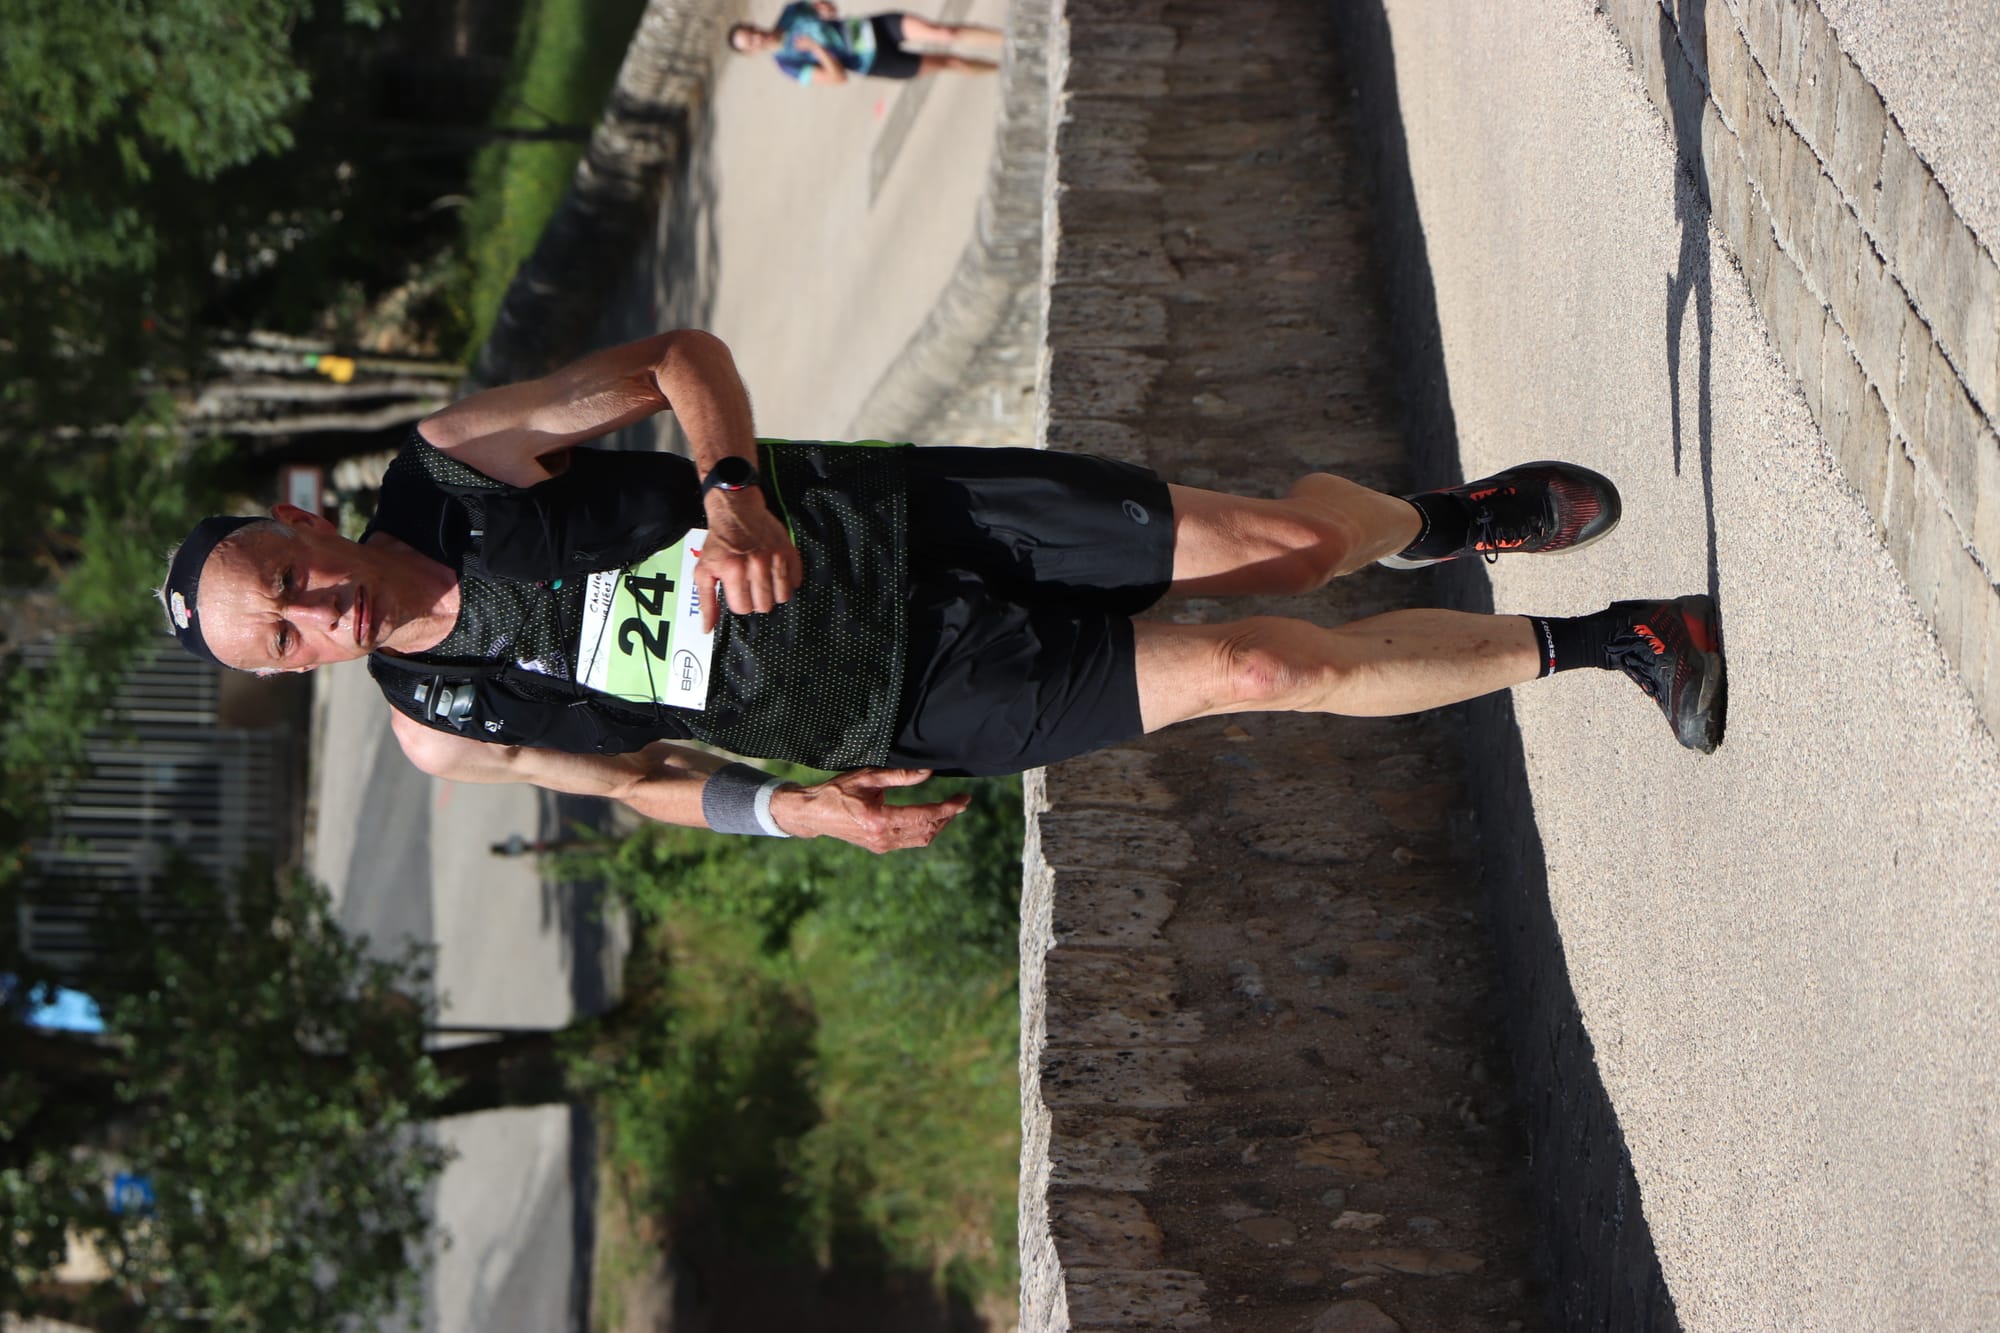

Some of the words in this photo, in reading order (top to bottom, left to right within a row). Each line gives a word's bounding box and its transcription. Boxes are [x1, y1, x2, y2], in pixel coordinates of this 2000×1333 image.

[589, 573, 602, 614] Challe
[618, 572, 675, 661] 24
[680, 656, 693, 692] BFP
